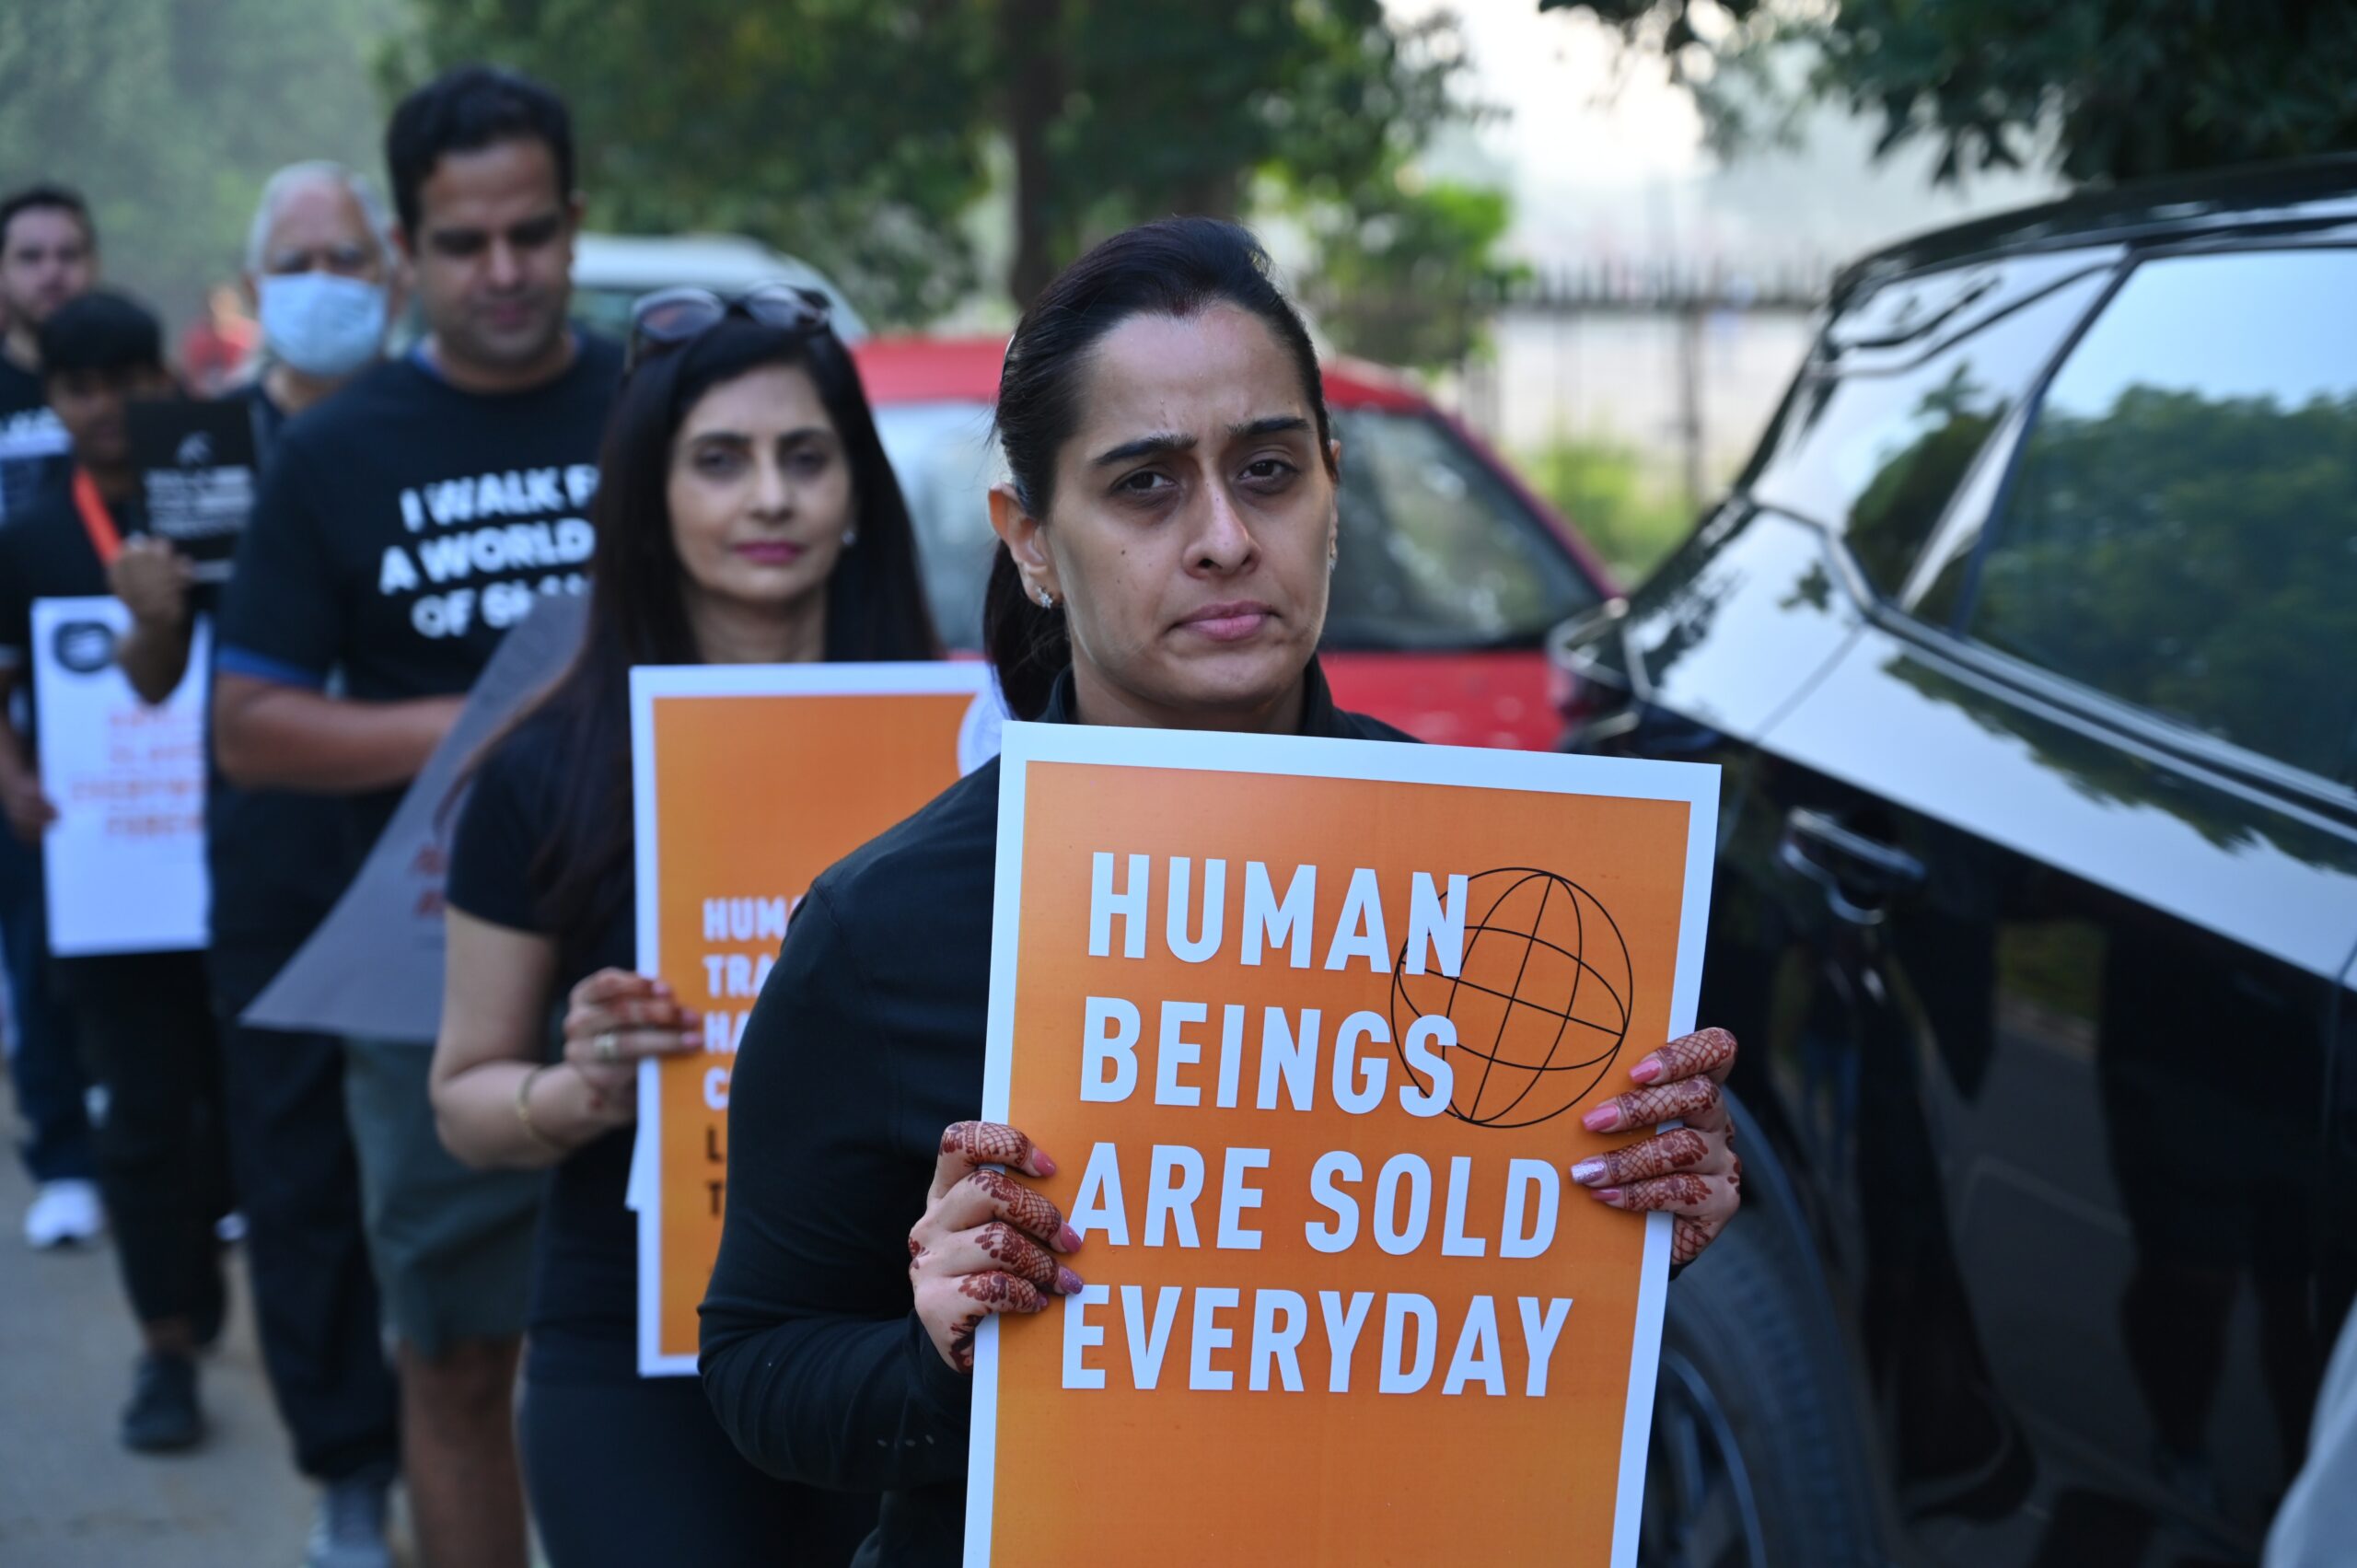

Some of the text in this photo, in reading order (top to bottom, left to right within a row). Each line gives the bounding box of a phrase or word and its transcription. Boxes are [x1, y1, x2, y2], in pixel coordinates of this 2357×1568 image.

[400, 463, 600, 532] I WALK F
[378, 518, 595, 595] A WORLD
[411, 588, 475, 638] OF
[703, 896, 804, 940] HUM
[1088, 851, 1469, 977] HUMAN
[702, 954, 773, 997] TRA
[702, 1066, 728, 1110] C
[1080, 996, 1458, 1117] BEINGS
[1067, 1143, 1561, 1258] ARE SOLD
[1062, 1284, 1573, 1397] EVERYDAY
